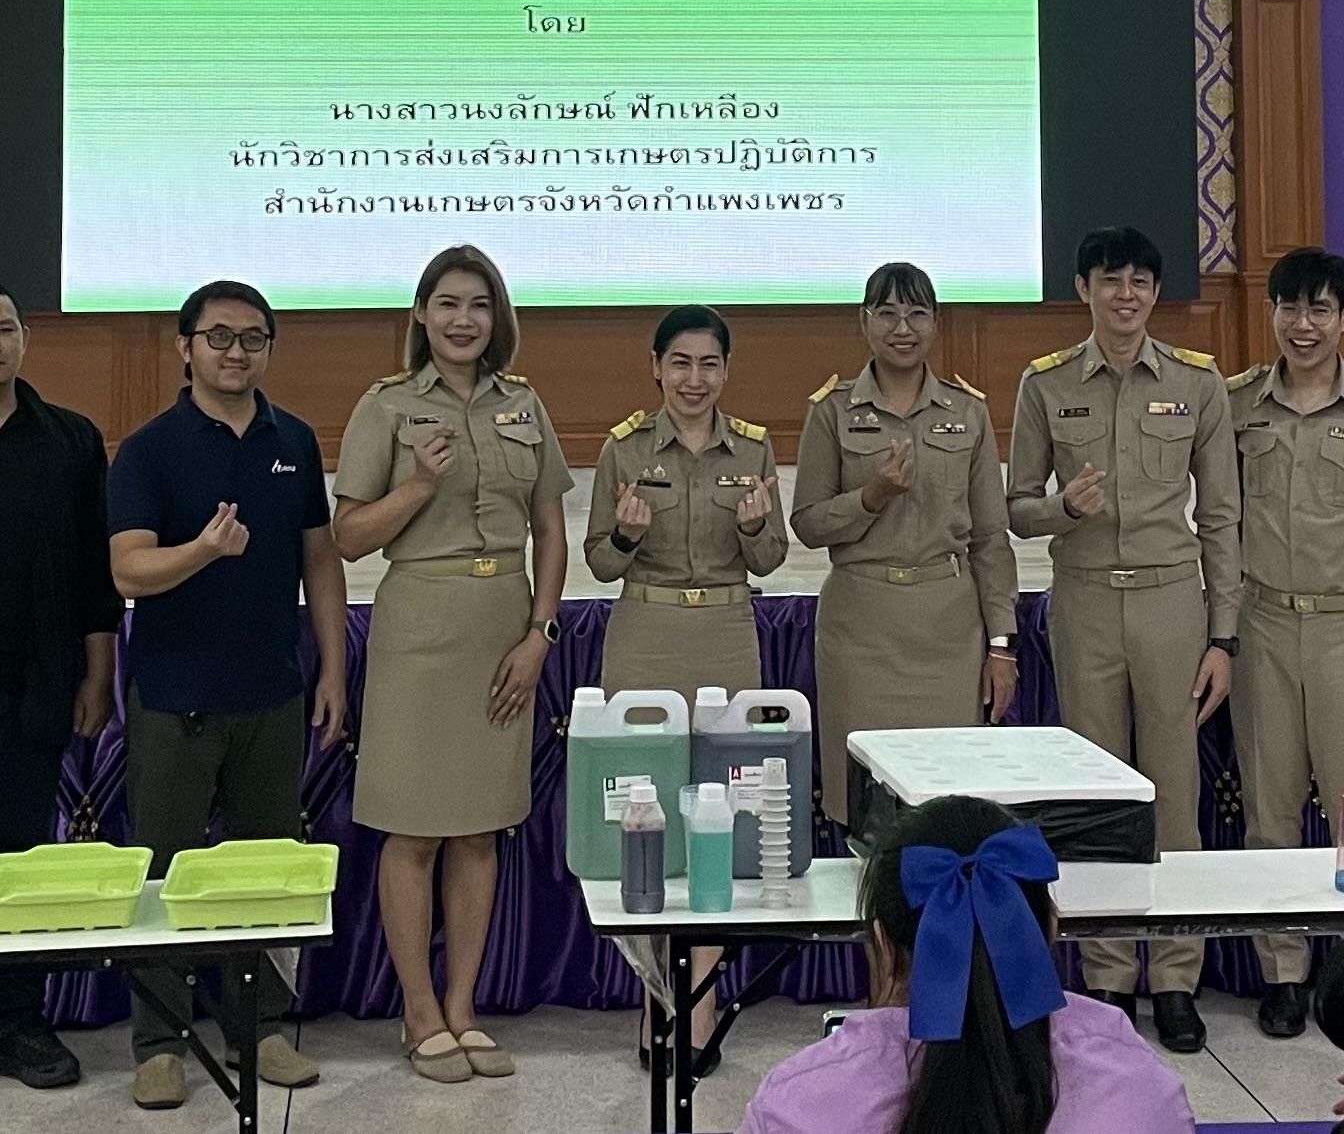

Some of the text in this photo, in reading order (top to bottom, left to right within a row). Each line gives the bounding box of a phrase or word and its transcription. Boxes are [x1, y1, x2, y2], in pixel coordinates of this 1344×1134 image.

[523, 4, 587, 34] โดย
[329, 91, 617, 121] นางสาวนงลักษณ์
[229, 138, 880, 172] นักวิชาการส่งเสริมการเกษตรปฏิบัติการ
[265, 184, 847, 214] สำนักงานเกษตรจังหวัดกำแพงเพชร
